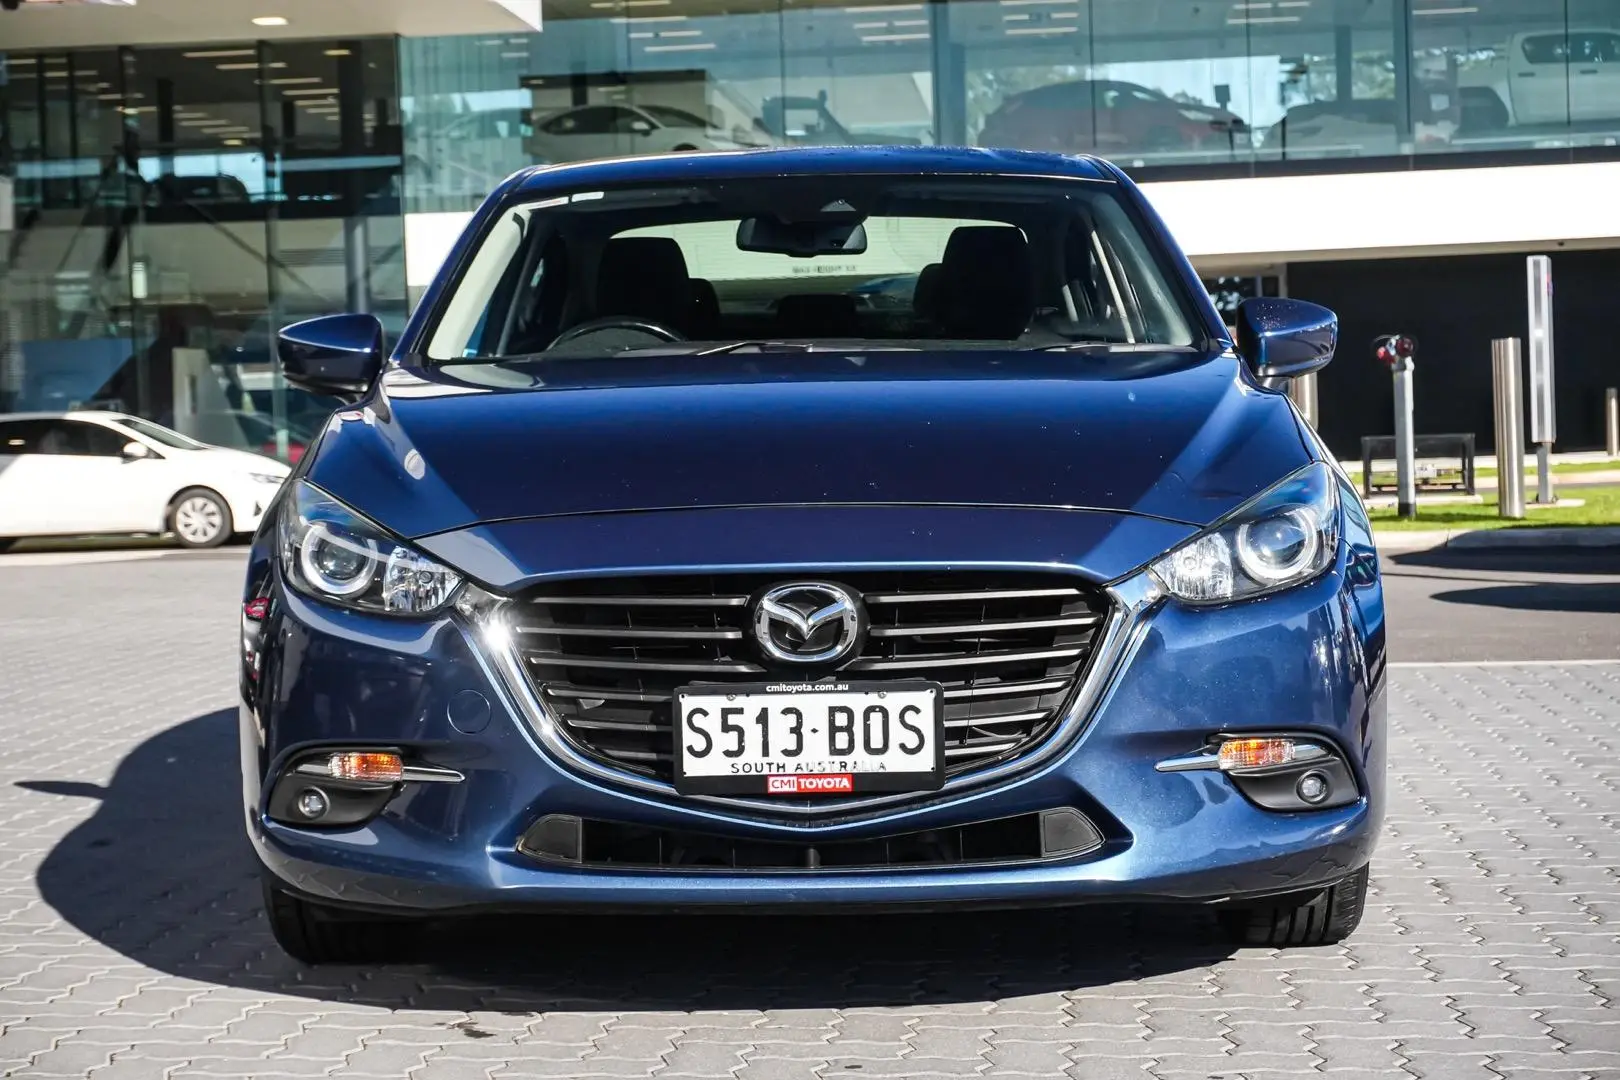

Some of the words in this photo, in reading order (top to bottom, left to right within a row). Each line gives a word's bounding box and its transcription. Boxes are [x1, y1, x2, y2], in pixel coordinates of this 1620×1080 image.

[765, 683, 849, 694] cmitoyota.com.au
[730, 762, 786, 774] SOUTH
[771, 779, 795, 789] CMI
[798, 778, 849, 789] TOYOTA
